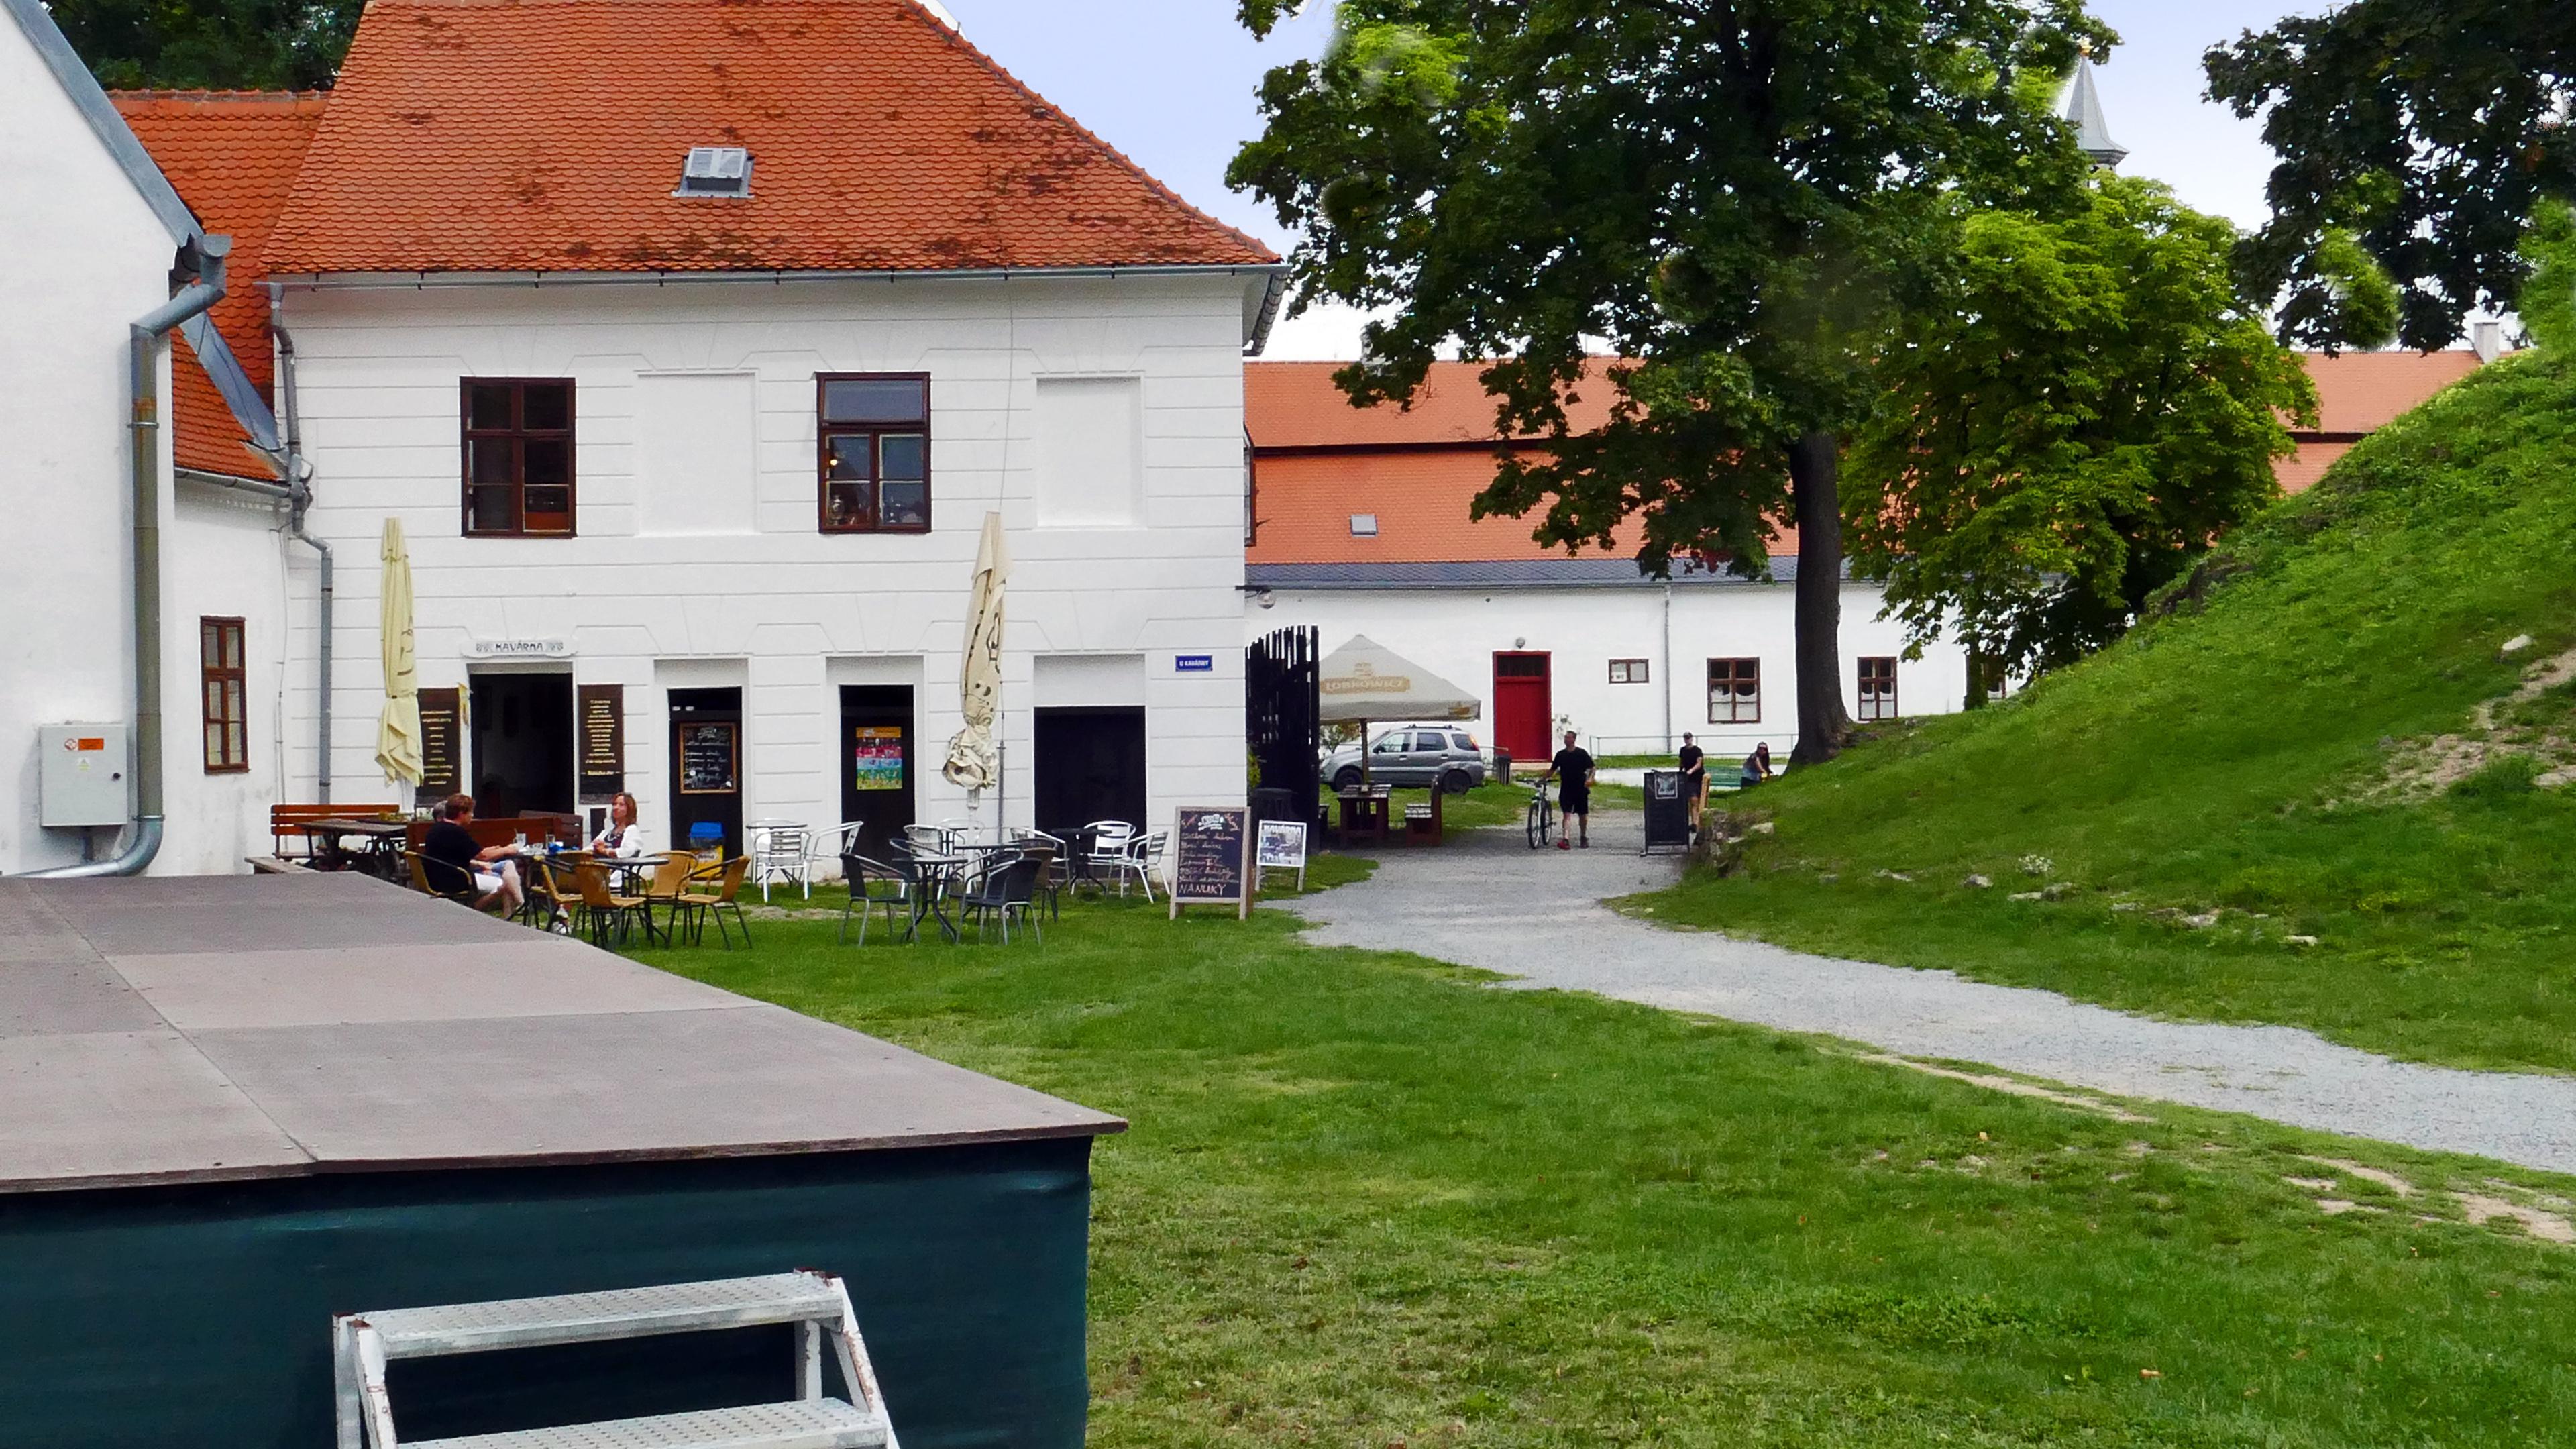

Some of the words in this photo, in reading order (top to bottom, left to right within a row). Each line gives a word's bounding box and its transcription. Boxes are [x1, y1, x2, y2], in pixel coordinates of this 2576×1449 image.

[496, 641, 543, 651] KAVÁRNA
[1325, 680, 1403, 692] LOBKOWICZ
[1179, 883, 1226, 896] NANUKY
